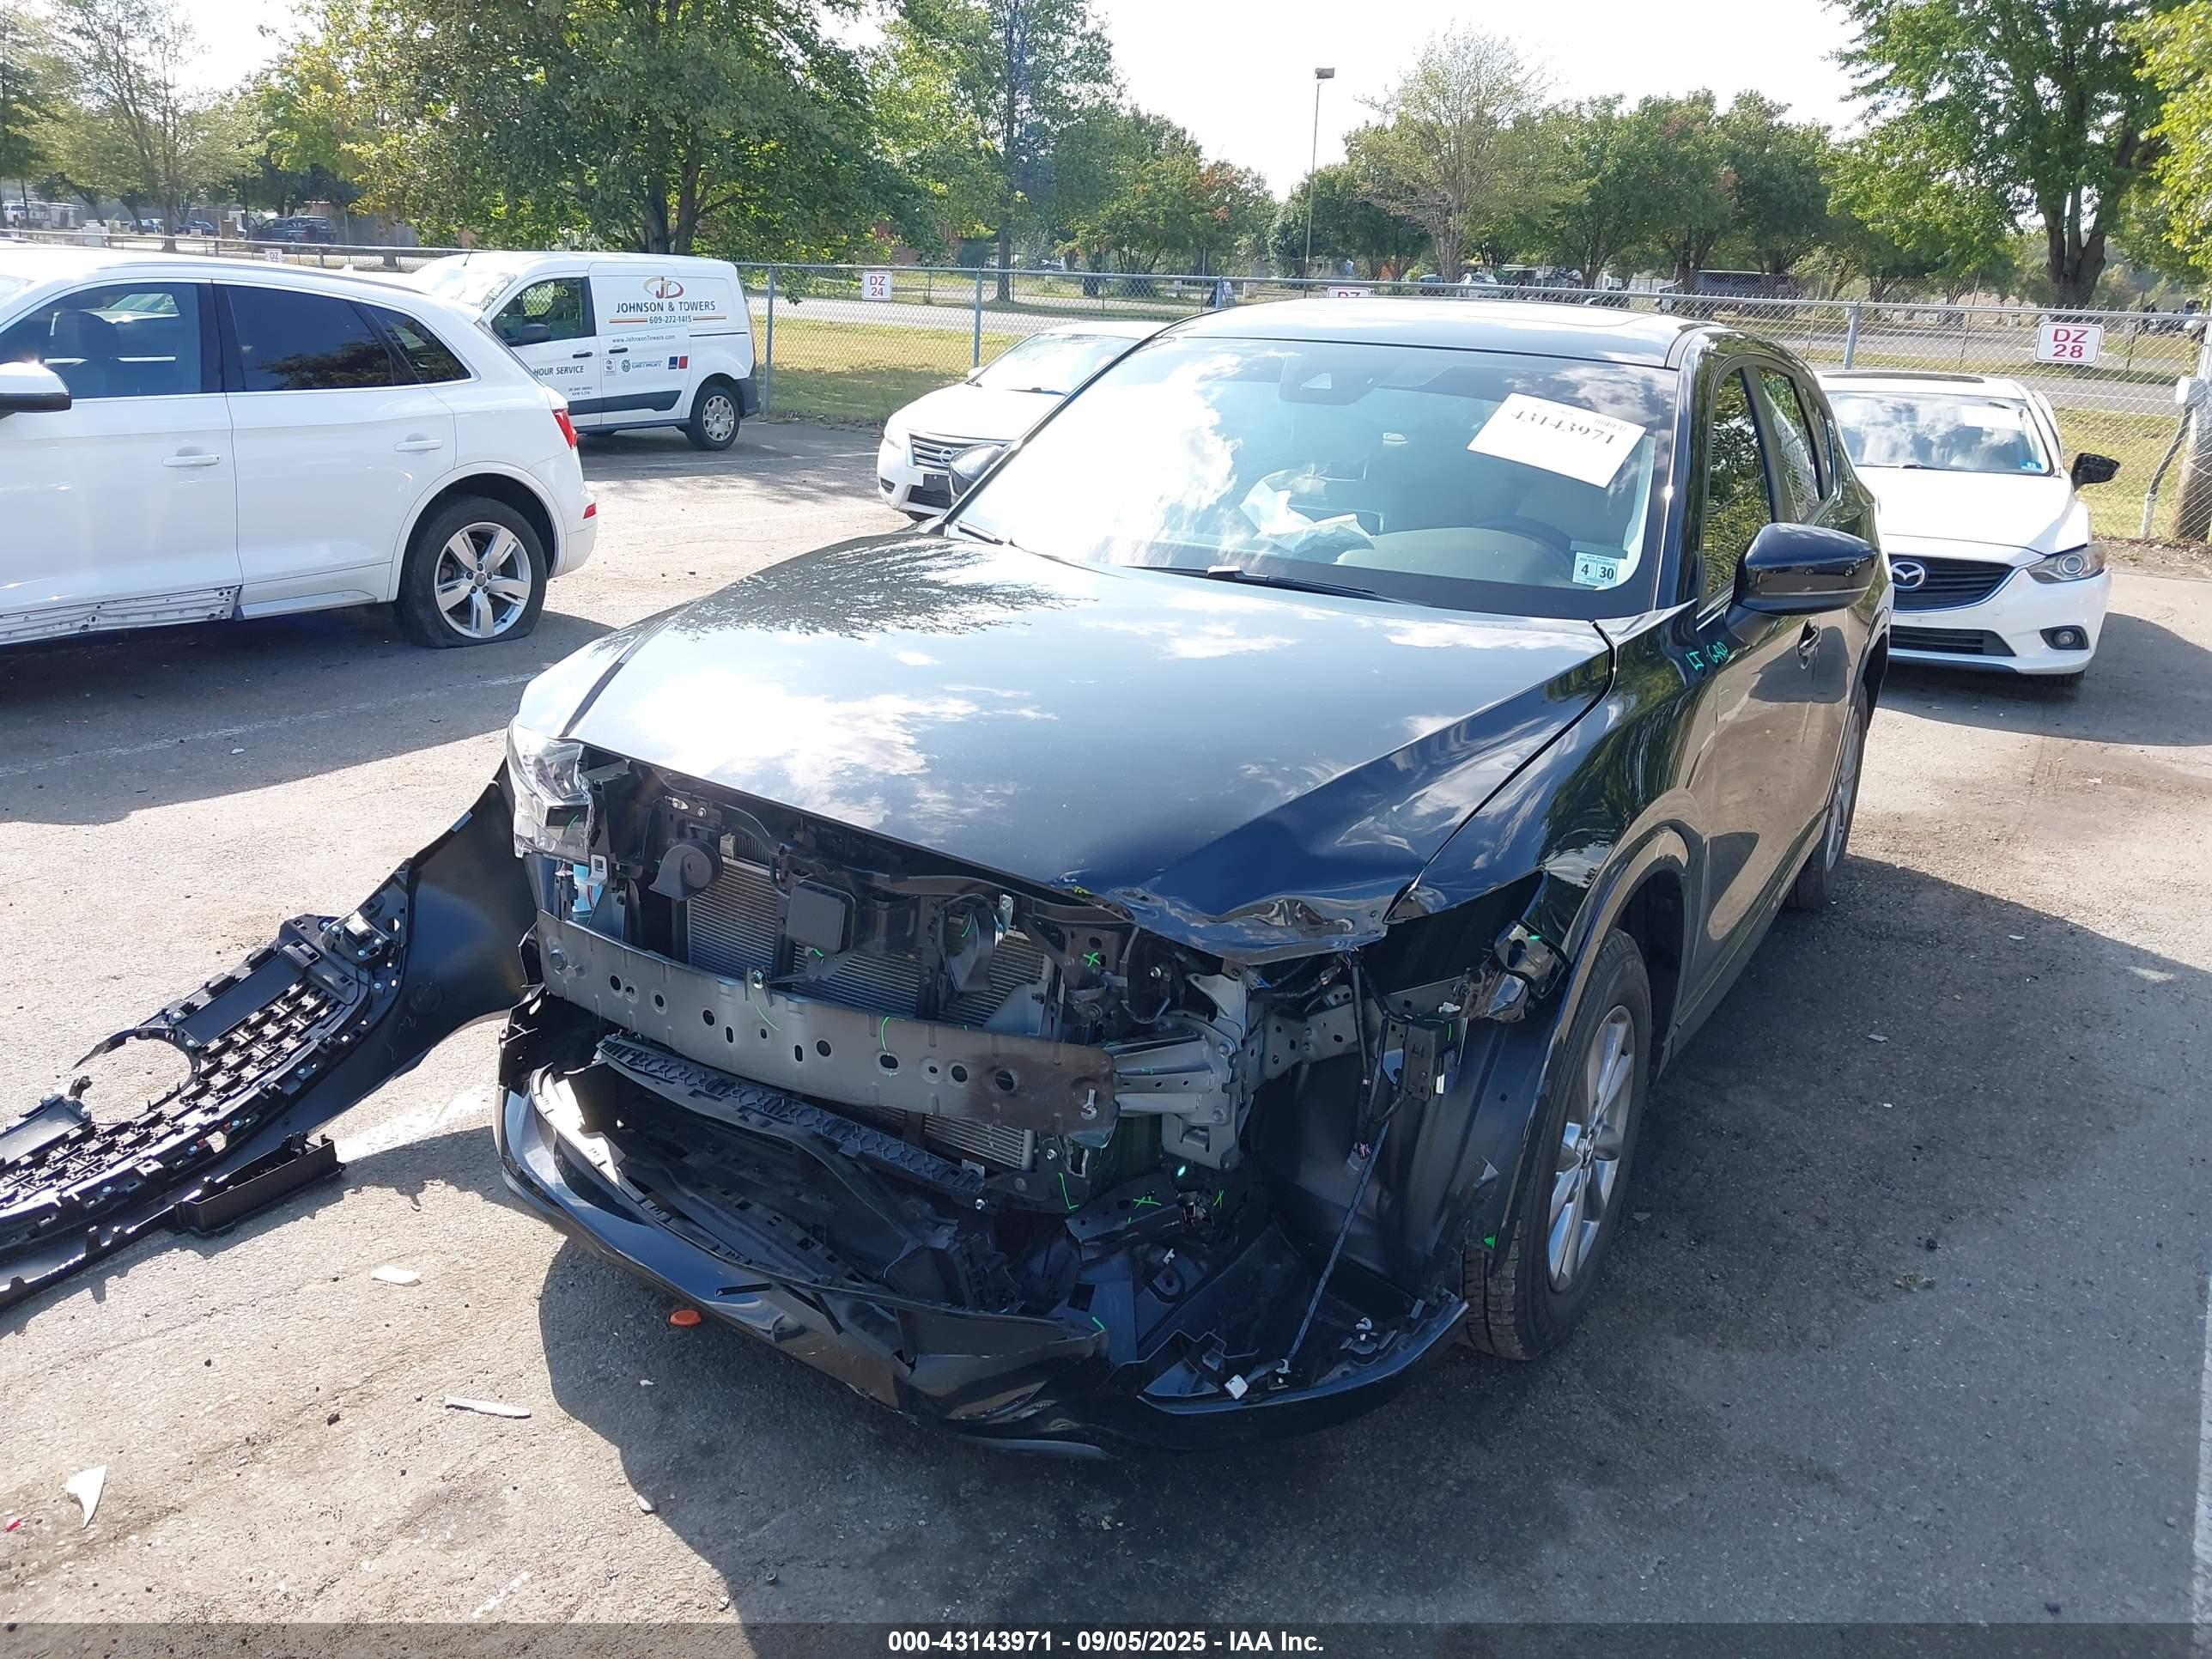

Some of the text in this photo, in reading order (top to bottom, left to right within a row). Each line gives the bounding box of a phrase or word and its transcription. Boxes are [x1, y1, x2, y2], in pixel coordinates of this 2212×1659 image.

[870, 276, 886, 286] DZ
[871, 287, 884, 296] 24
[617, 301, 715, 313] JOHNSON & TOWERS
[649, 315, 692, 324] 609-272-1415
[2053, 328, 2089, 343] DZ
[2052, 343, 2083, 359] 28
[533, 365, 585, 376] HOUR SERVICE
[1510, 410, 1616, 445] 43143971
[1581, 563, 1614, 580] 4 30
